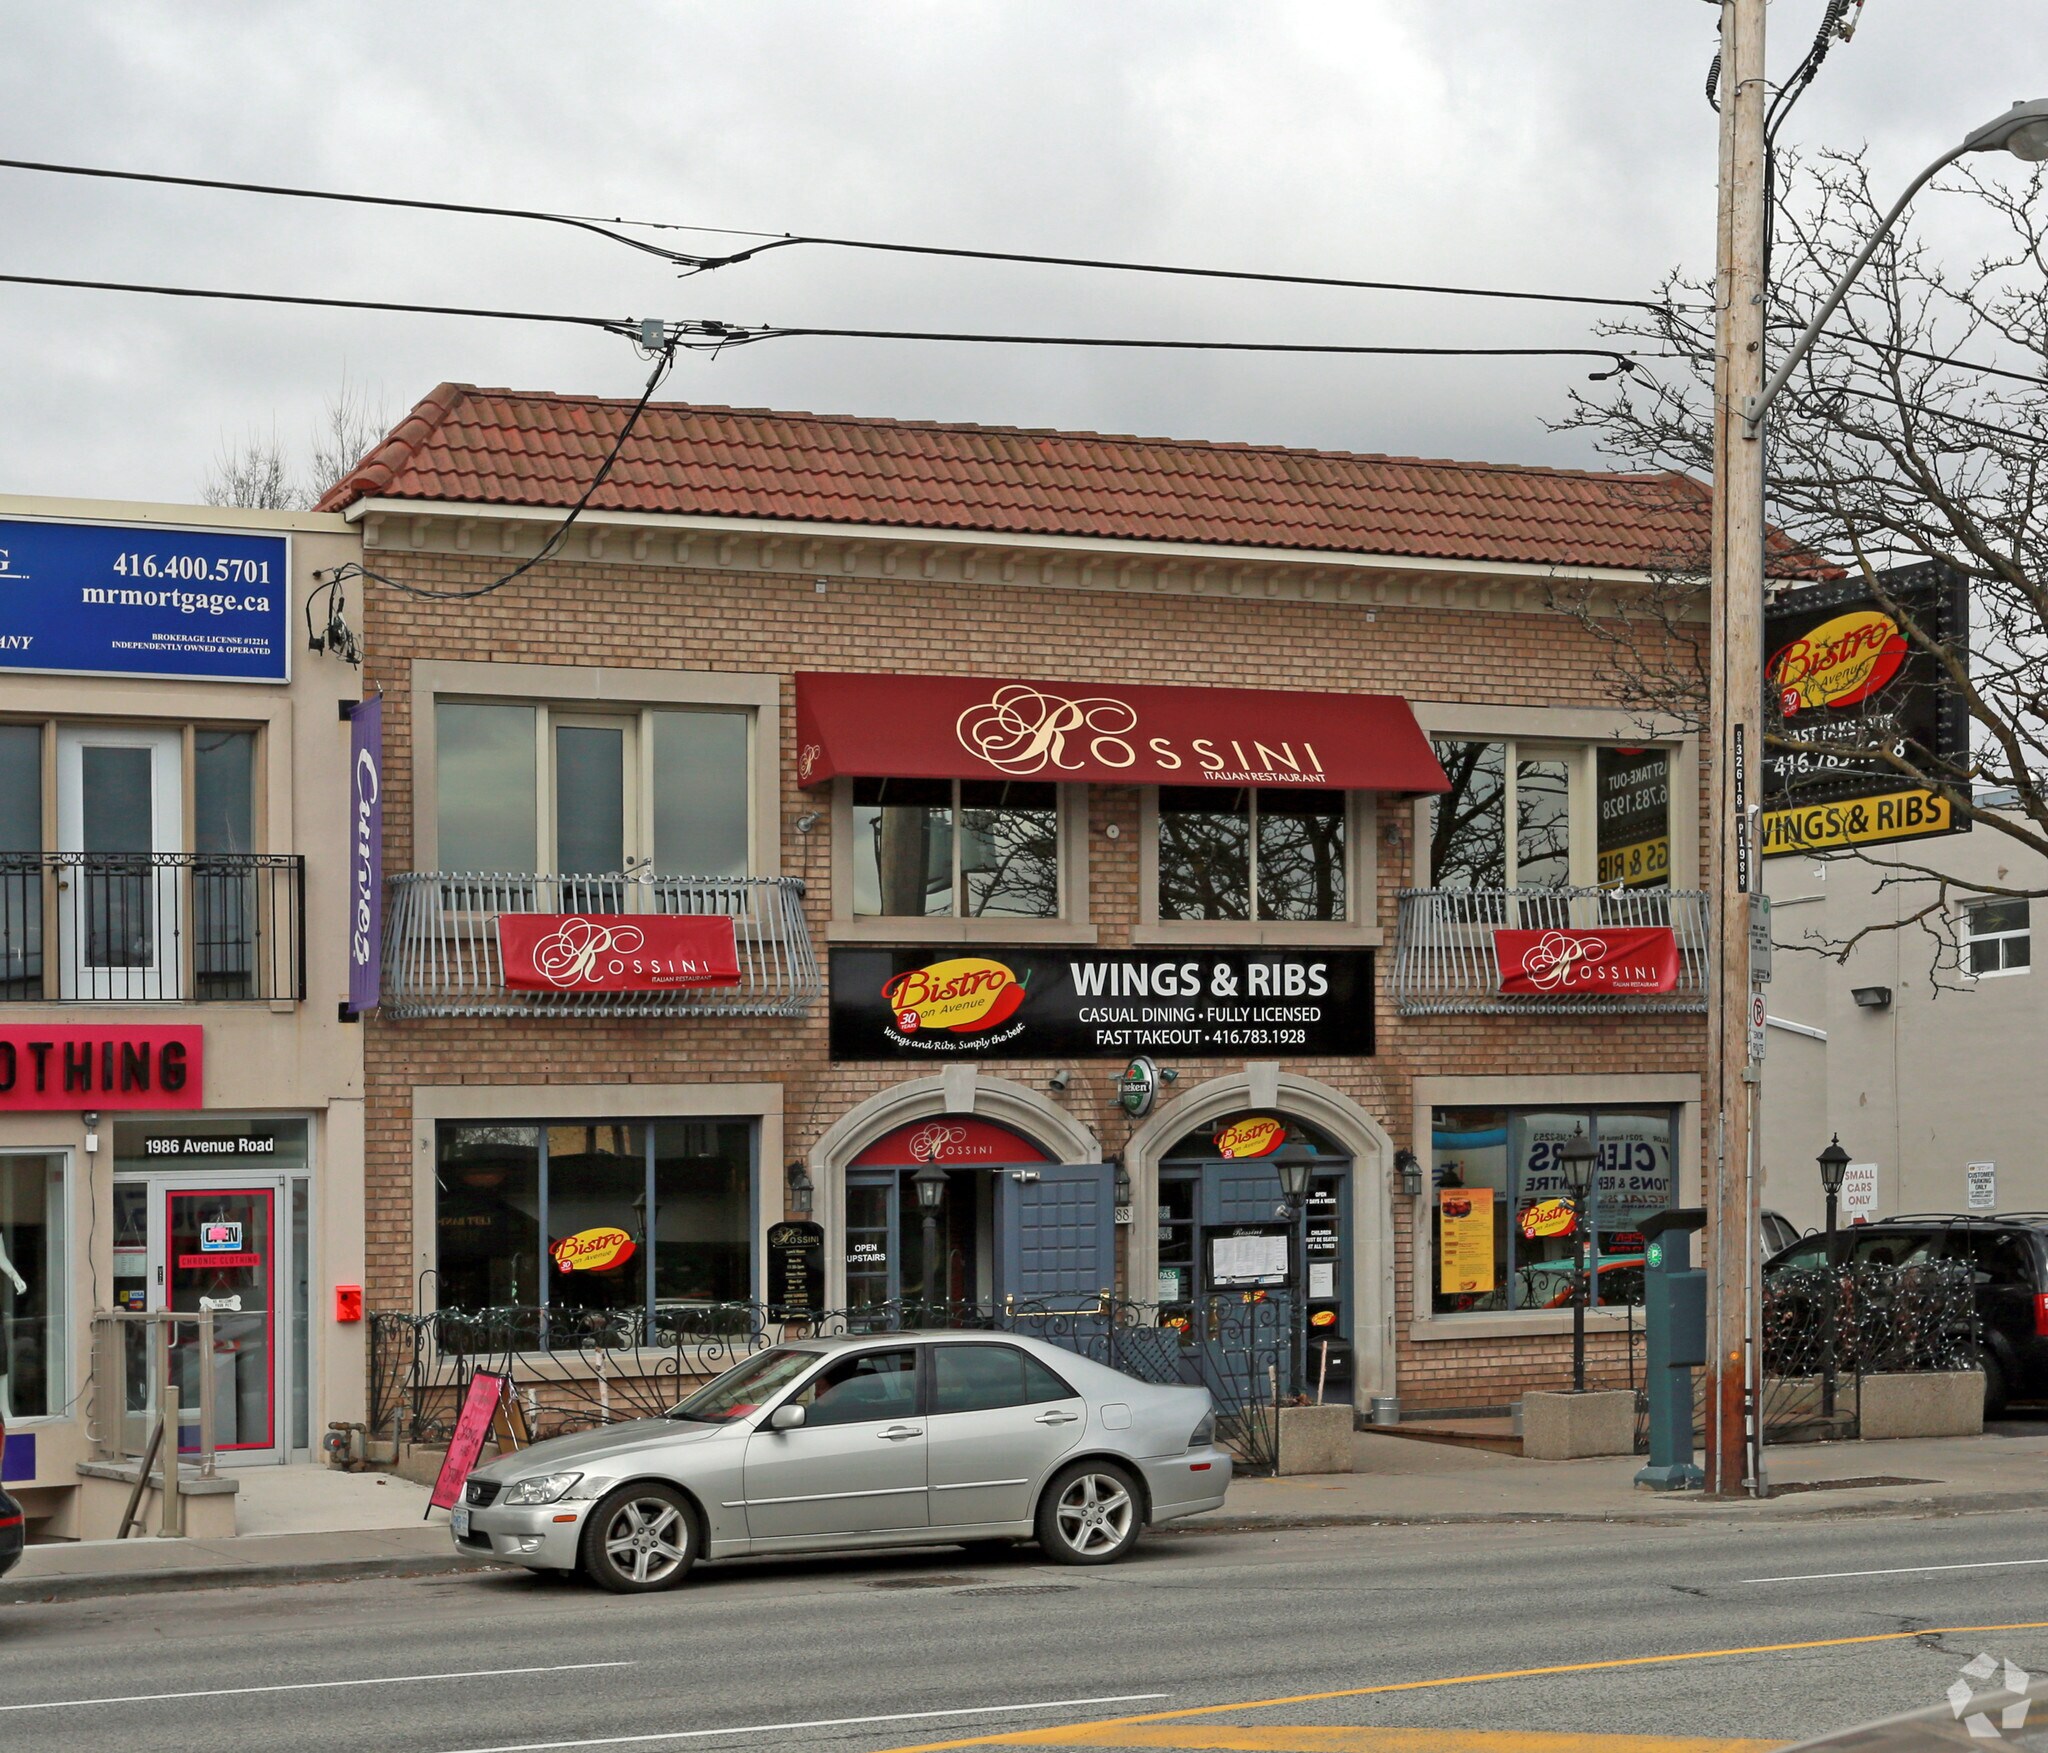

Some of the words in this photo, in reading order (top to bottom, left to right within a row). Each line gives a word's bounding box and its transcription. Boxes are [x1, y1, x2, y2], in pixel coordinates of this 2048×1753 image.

[113, 553, 270, 584] 416.400.5701
[82, 587, 270, 615] mrmortgage.ca
[152, 633, 205, 643] BROKERAGE
[207, 635, 243, 644] LICENSE
[112, 641, 182, 651] INDEPENDENTLY
[184, 644, 216, 653] OWNED
[226, 646, 271, 655] OPERATED
[1764, 622, 1888, 689] Bistro
[1203, 771, 1249, 782] ITALIAN
[1251, 772, 1326, 783] RESTAURANT
[1850, 804, 1869, 834] &
[1877, 794, 1942, 831] RIBS
[353, 748, 378, 966] Curves
[1070, 963, 1201, 997] WINGS
[1210, 963, 1239, 997] &
[1248, 963, 1328, 997] RIBS
[881, 968, 1007, 1011] Bistro
[921, 1008, 936, 1019] on
[940, 997, 985, 1015] Avenue
[1079, 1007, 1138, 1022] CASUAL
[1142, 1007, 1195, 1022] DINING
[1207, 1007, 1250, 1022] FULLY
[1254, 1007, 1321, 1022] LICENSED
[900, 1012, 917, 1025] 30
[884, 1026, 911, 1047] Wings
[912, 1040, 934, 1049] and
[991, 1034, 1008, 1045] the
[1007, 1022, 1026, 1038] best.
[1096, 1030, 1132, 1045] FAST
[1134, 1030, 1202, 1045] TAKEOUT
[1213, 1029, 1306, 1045] 416.783.1928
[1213, 1122, 1276, 1150] Bistro
[145, 1139, 180, 1154] 1986
[183, 1139, 235, 1153] Avenue
[239, 1138, 274, 1152] Road
[1845, 1170, 1875, 1180] SMALL
[1847, 1183, 1872, 1192] CARS
[1848, 1195, 1871, 1205] ONLY
[548, 1234, 624, 1261] Bistro
[855, 1244, 877, 1252] OPEN
[182, 1257, 217, 1266] CHRONIC
[220, 1255, 258, 1265] CLOTHING
[584, 1250, 612, 1261] Avenue
[847, 1253, 886, 1262] UPSTAIRS
[1159, 1271, 1176, 1279] PASS
